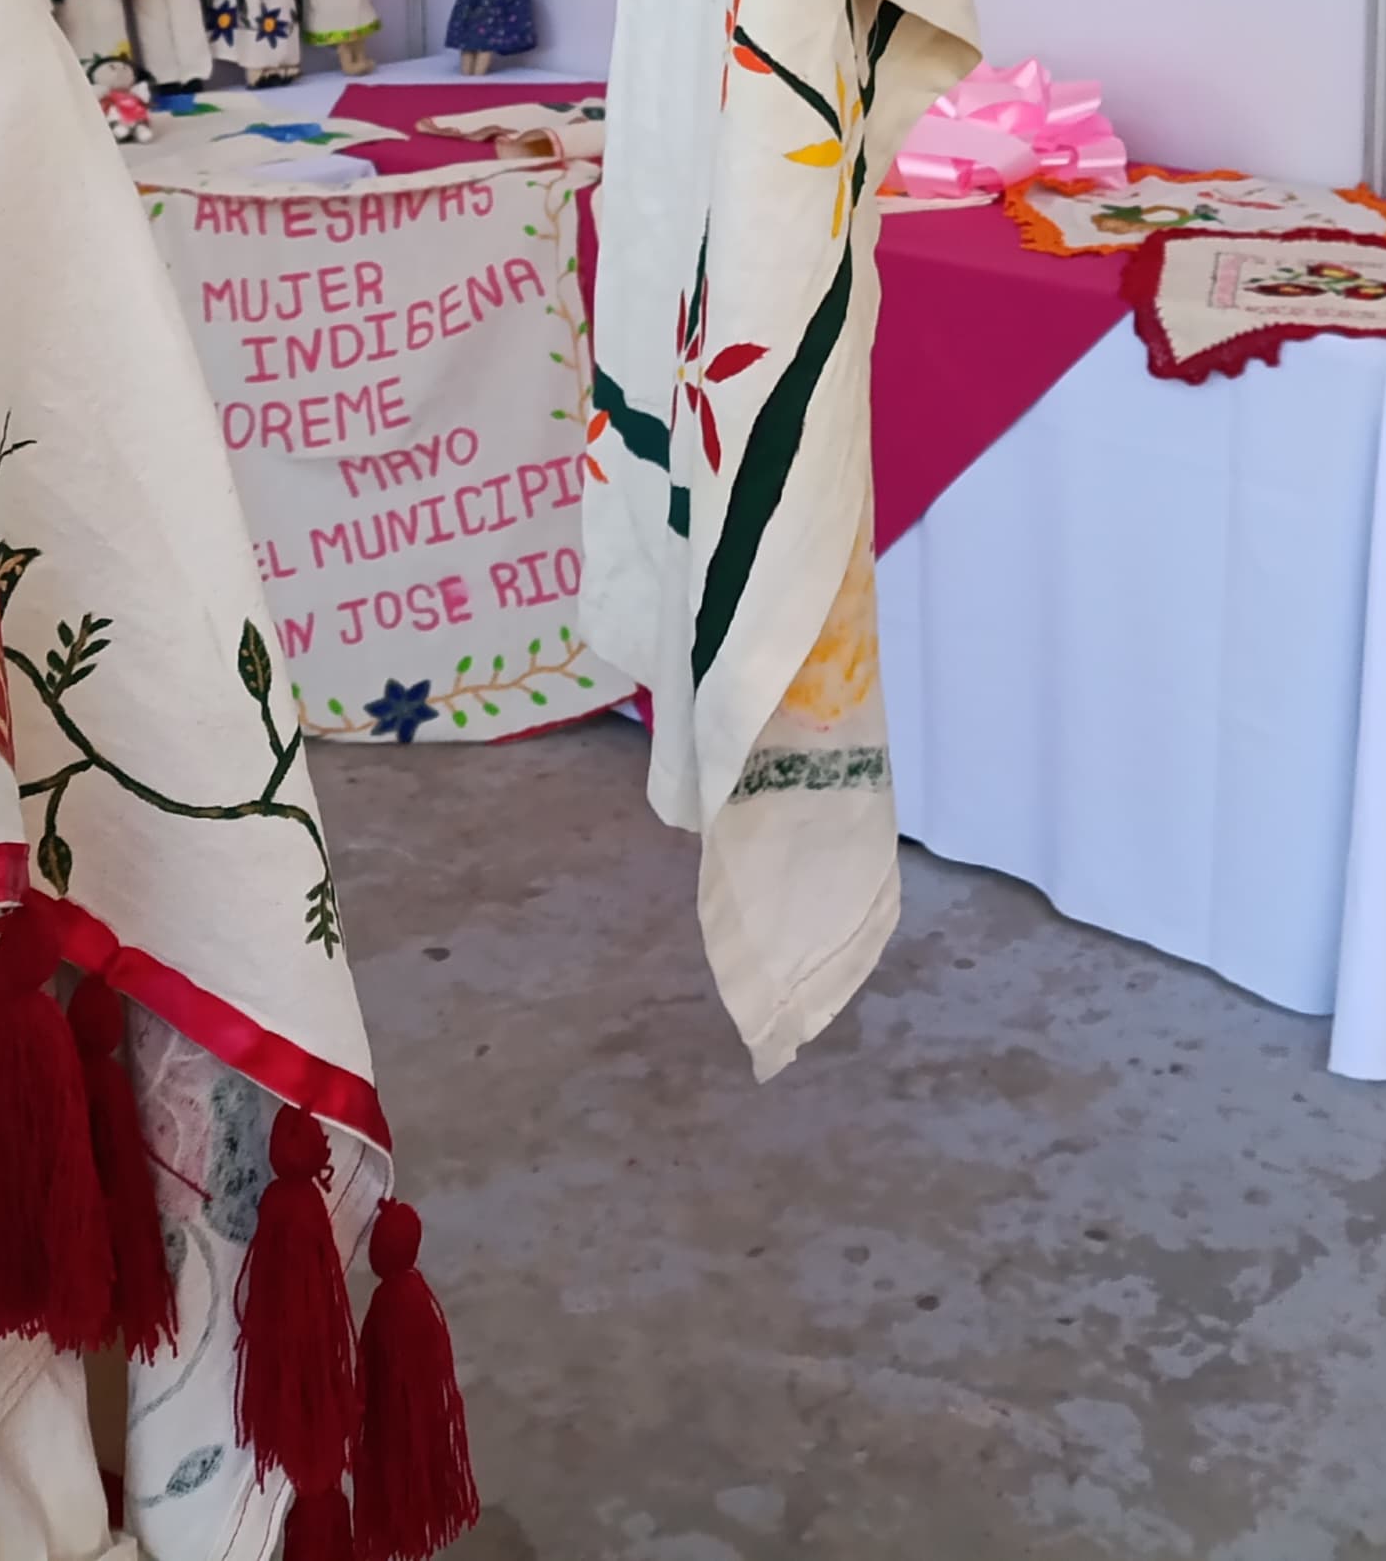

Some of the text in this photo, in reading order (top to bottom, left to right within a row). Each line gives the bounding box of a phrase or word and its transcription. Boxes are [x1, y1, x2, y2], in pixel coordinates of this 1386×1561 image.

[202, 261, 383, 323] MUJER
[241, 258, 546, 383] INDIGENA
[215, 376, 411, 454] OREME
[338, 426, 479, 499] MAYO
[336, 574, 474, 645] JOSE
[489, 547, 582, 609] RIO
